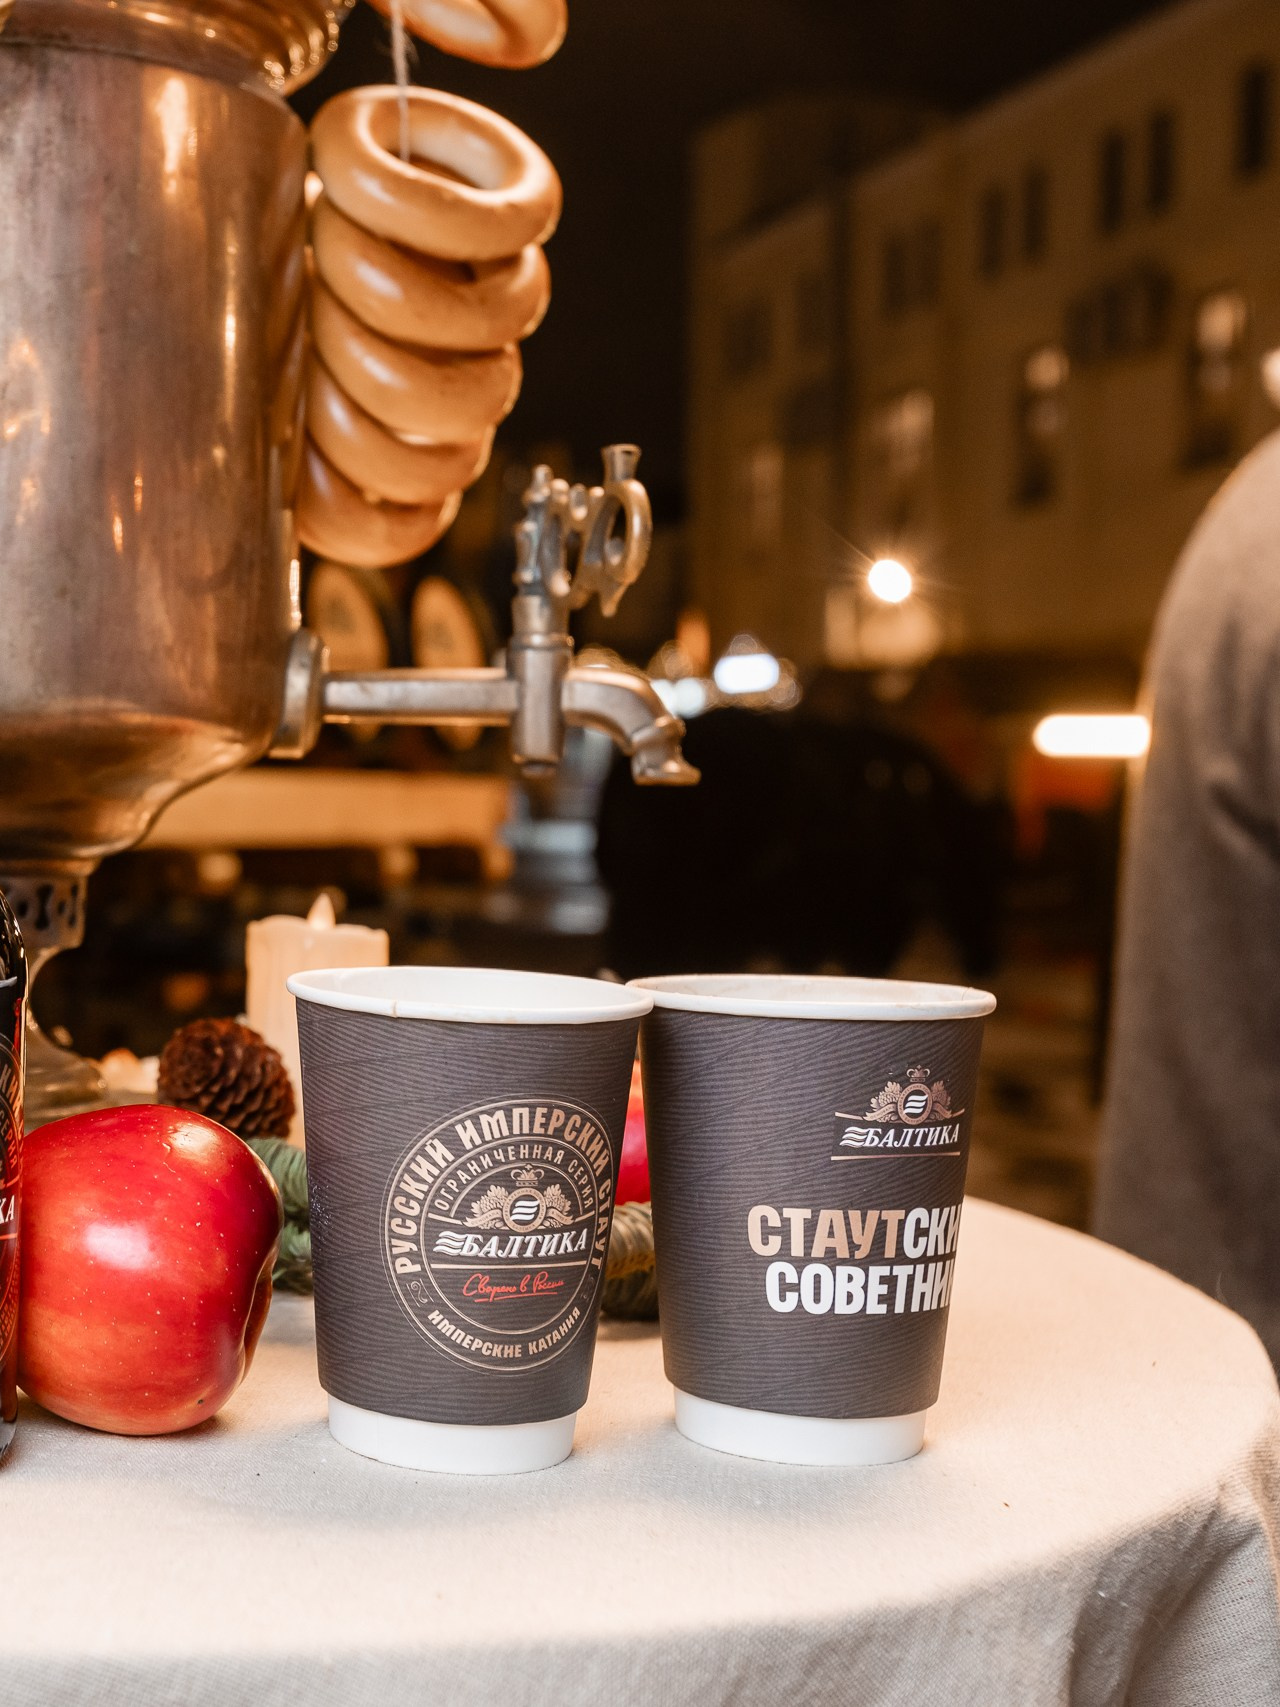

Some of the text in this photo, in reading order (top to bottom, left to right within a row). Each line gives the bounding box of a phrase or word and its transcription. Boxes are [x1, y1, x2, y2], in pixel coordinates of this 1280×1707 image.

[863, 1123, 960, 1148] БАЛТИКА
[391, 1107, 611, 1274] РУССКИЙ ИМПЕРСКИЙ СТАУТ
[434, 1144, 565, 1211] ОГРАНИЧЕННАЯ
[567, 1159, 594, 1209] СЕРИЯ
[461, 1228, 587, 1258] БАЛТИКА
[520, 1276, 530, 1291] в
[427, 1306, 581, 1358] ИМПЕРСКИЕ КАТАНИЯ
